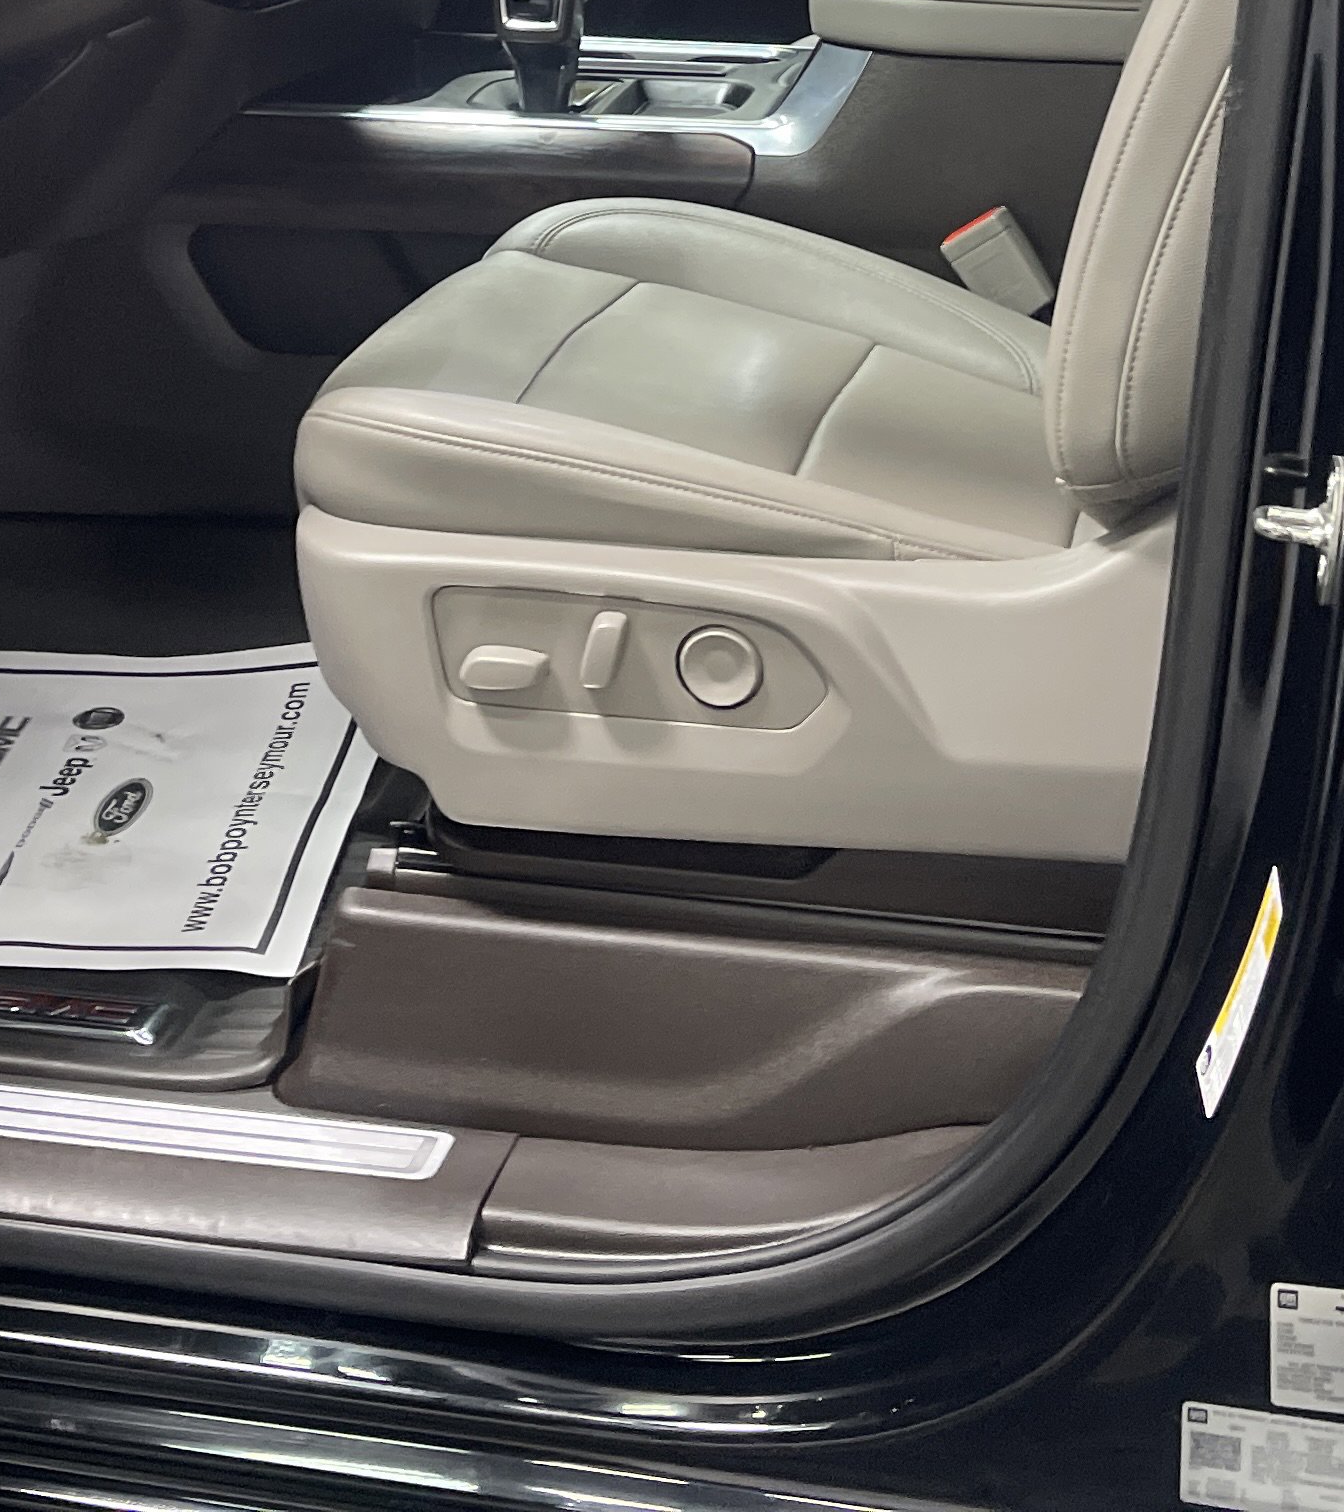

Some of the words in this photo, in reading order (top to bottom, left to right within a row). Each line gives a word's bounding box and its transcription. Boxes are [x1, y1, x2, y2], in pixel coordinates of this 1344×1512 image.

[39, 755, 95, 797] Jeep
[102, 790, 144, 824] Ford
[181, 681, 311, 934] www.bobpoynterseymour.com
